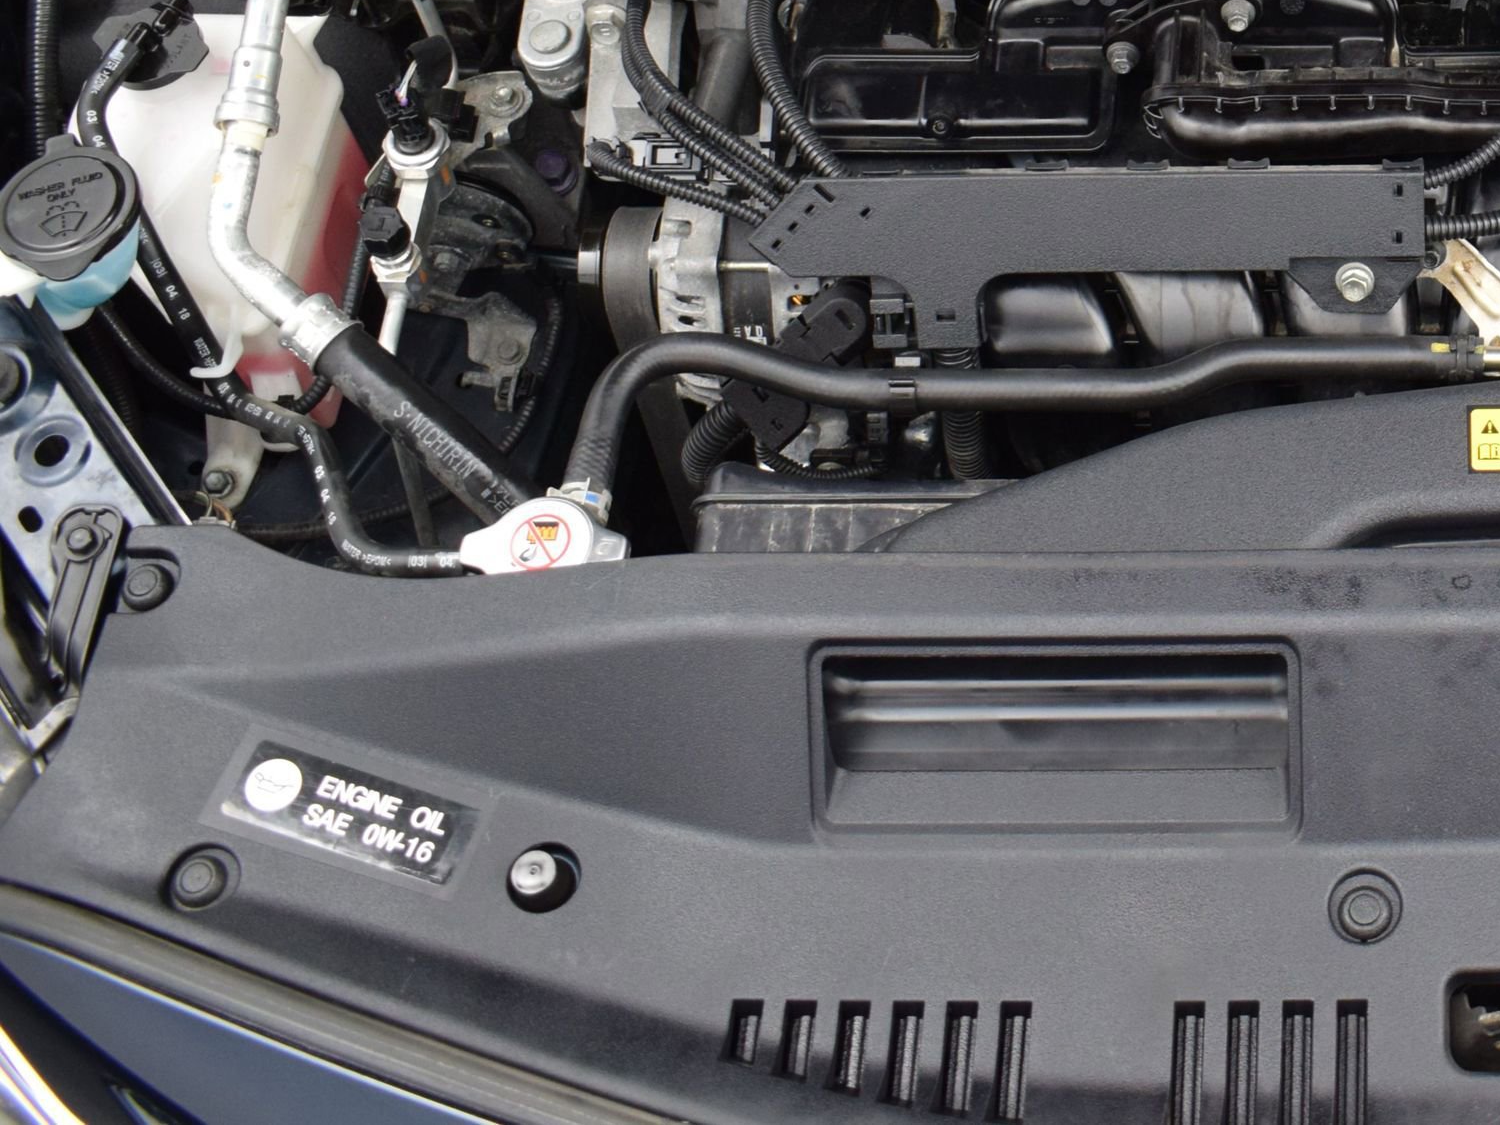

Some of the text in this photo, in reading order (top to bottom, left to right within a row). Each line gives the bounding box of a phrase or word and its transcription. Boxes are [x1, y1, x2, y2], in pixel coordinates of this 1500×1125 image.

[17, 171, 104, 201] WASHER FLUID
[46, 188, 76, 203] ONLY
[302, 803, 354, 836] SAE
[315, 775, 446, 837] ENGINE OIL
